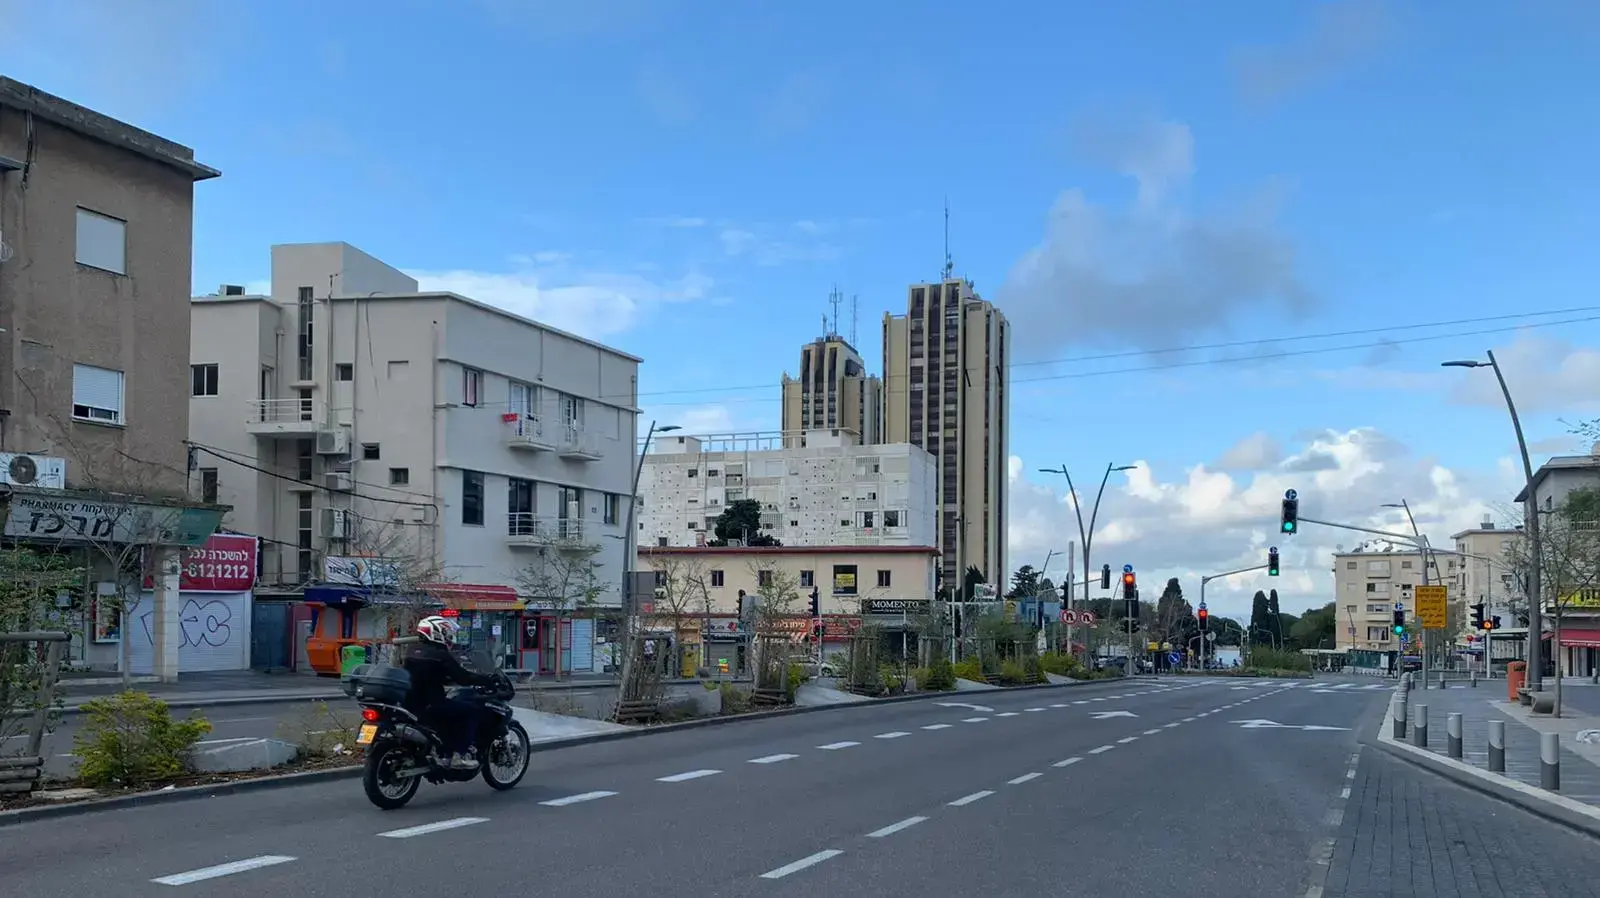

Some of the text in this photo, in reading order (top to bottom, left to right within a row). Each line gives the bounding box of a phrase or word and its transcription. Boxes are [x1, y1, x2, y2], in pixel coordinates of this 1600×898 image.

[20, 499, 77, 512] PHARMACY
[30, 511, 114, 537] מרכז
[208, 549, 248, 561] להשכרה
[872, 600, 919, 608] MOMENTO
